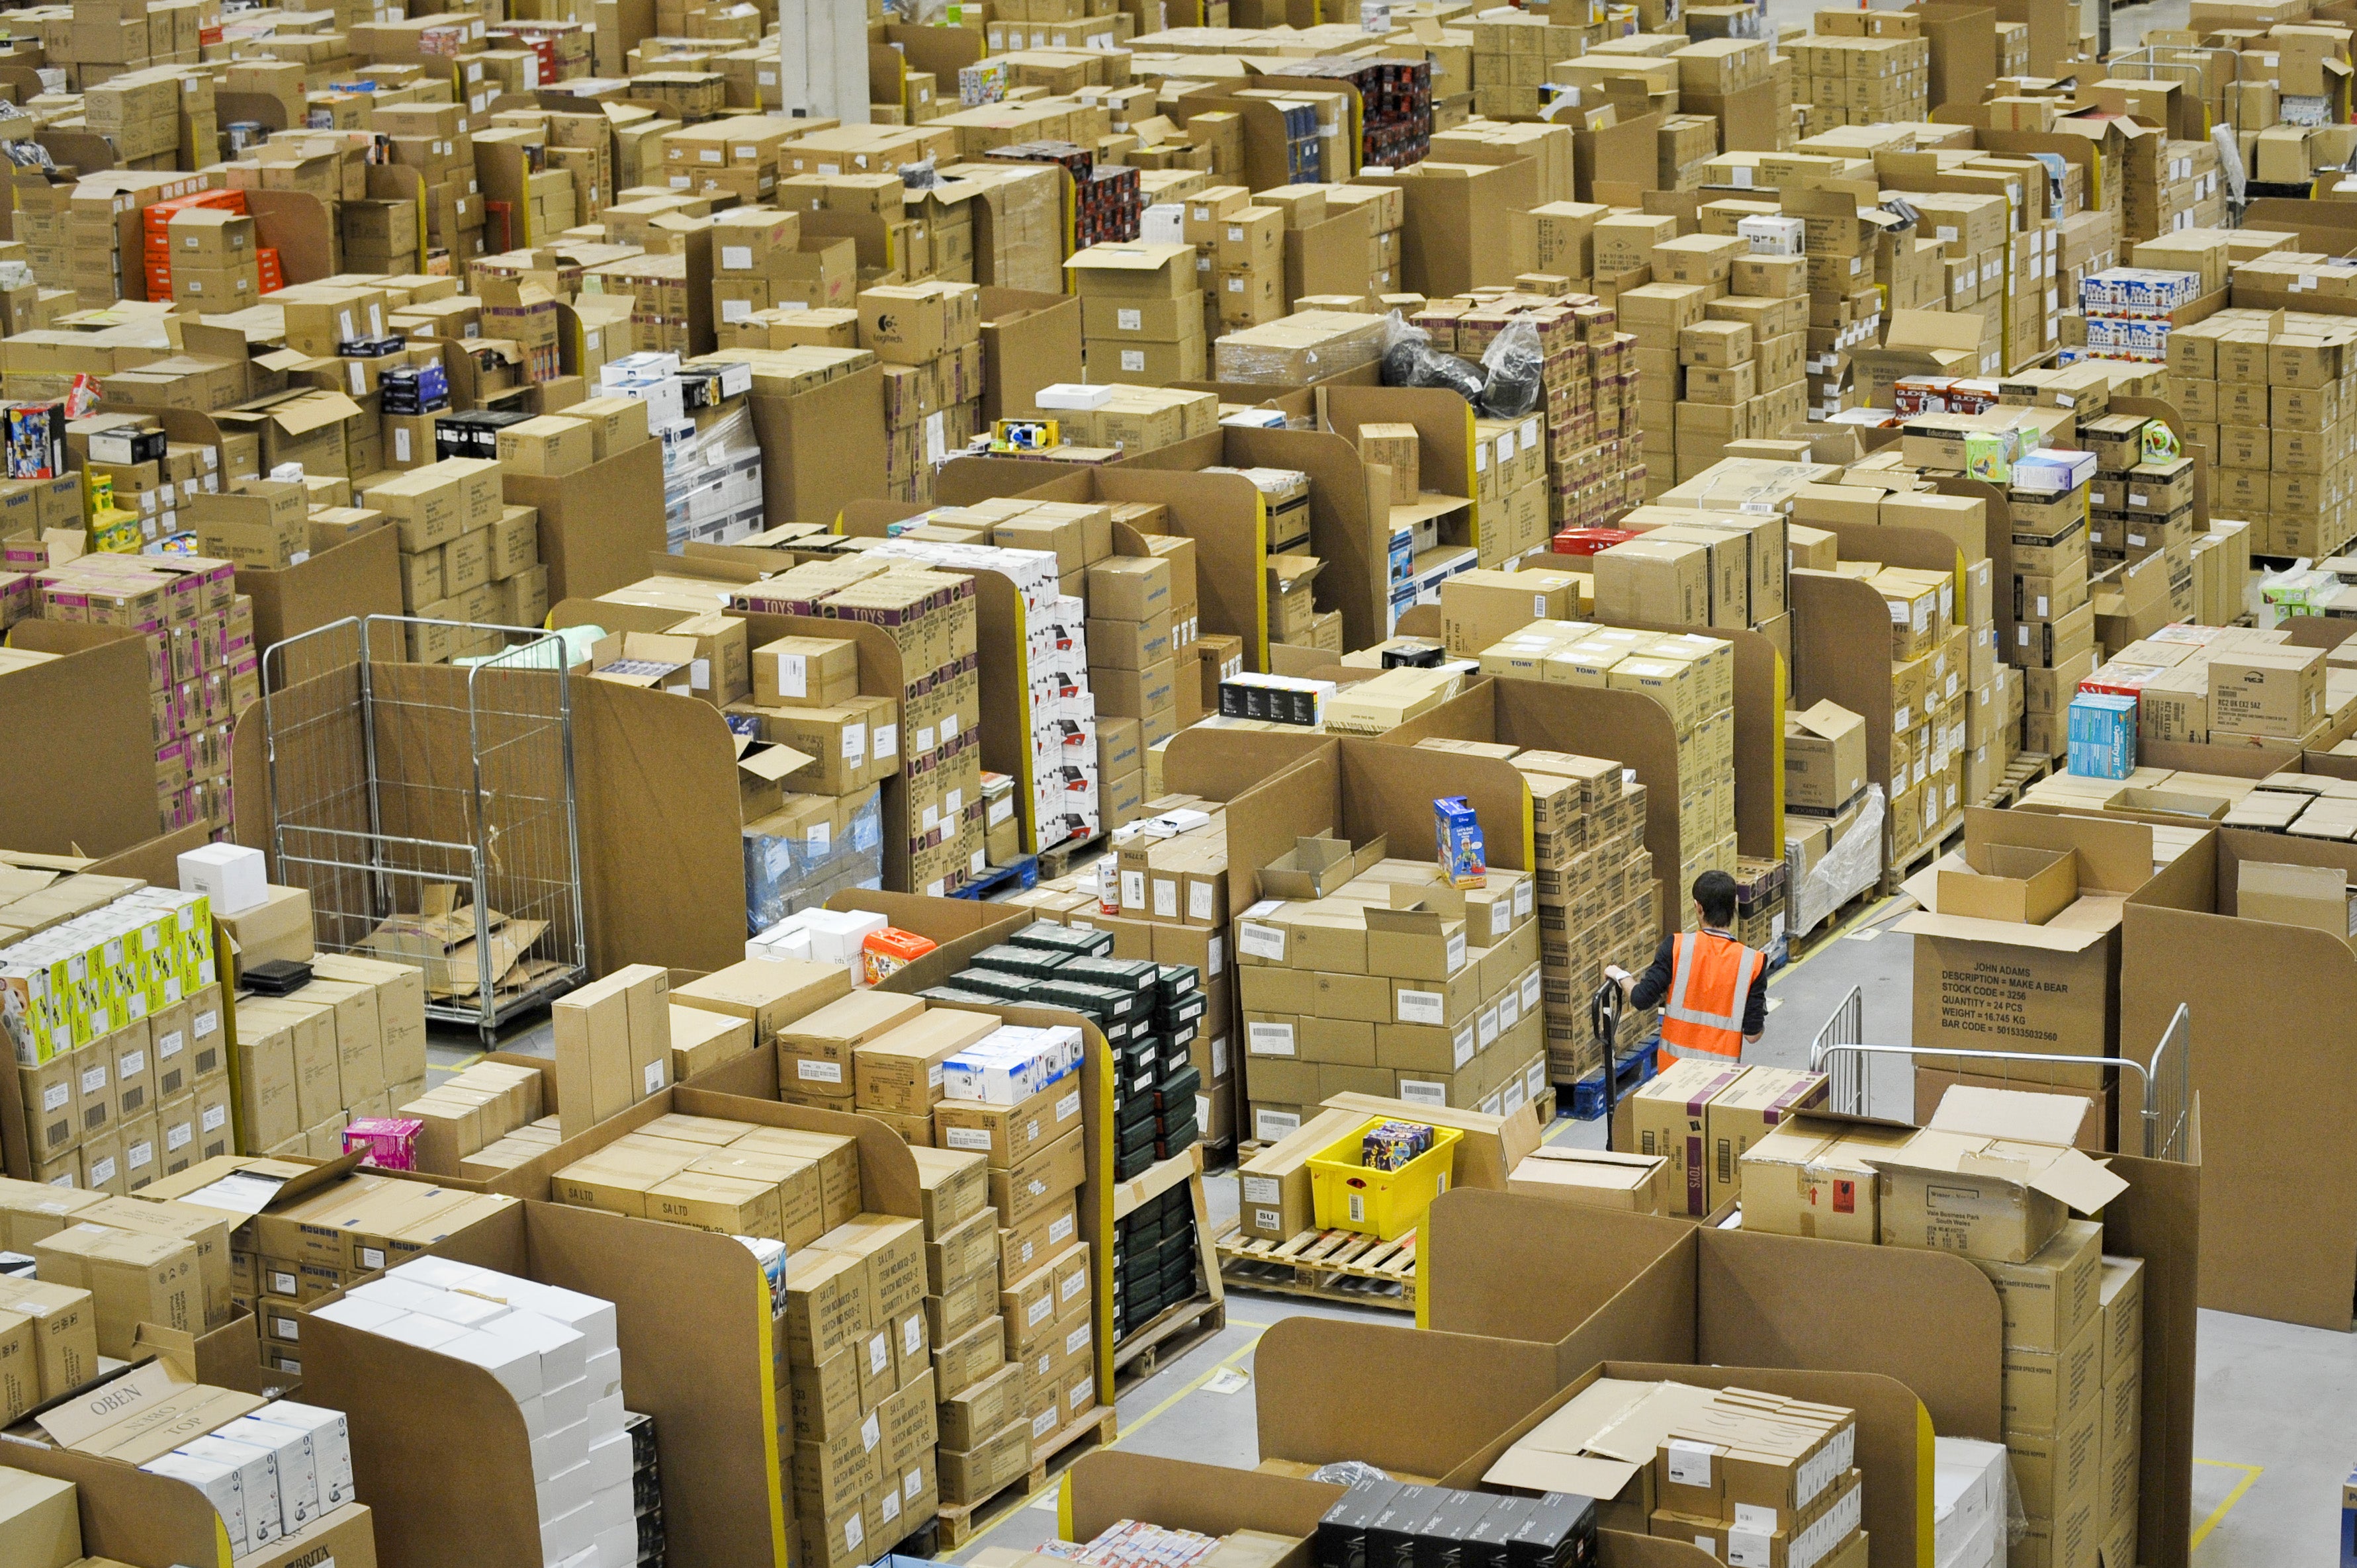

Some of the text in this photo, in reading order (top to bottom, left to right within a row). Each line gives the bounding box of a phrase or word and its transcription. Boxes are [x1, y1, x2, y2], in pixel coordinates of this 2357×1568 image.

[873, 333, 903, 345] Logitech
[1926, 429, 1962, 439] Educational
[53, 481, 76, 494] TOMY
[5, 494, 30, 508] TOMY
[763, 599, 795, 615] TOYS
[851, 607, 885, 625] TOYS
[1575, 667, 1597, 675] TOMY
[1640, 678, 1663, 687] TOMY
[2218, 699, 2229, 707] RC2
[1791, 806, 1829, 816] KENWOOD
[1974, 963, 2031, 977] JOHN ADAMS
[1942, 971, 1999, 985] DESCRIPTION
[2009, 979, 2034, 990] MAKE
[2035, 982, 2042, 991] A
[2044, 982, 2068, 993] BEAR
[1942, 982, 1971, 994] STOCK
[1973, 986, 1998, 998] CODE
[1942, 996, 1984, 1008] QUANTITY
[1994, 1001, 2003, 1010] 24
[2006, 1002, 2023, 1012] PCS
[1942, 1007, 1975, 1019] WEIGHT
[1984, 1012, 2010, 1023] 16.745
[2013, 1016, 2026, 1025] KG
[1941, 1019, 1960, 1029] BAR
[1962, 1022, 1986, 1032] CODE
[1997, 1026, 2058, 1041] 5015335032560
[850, 1036, 864, 1048] omron
[1009, 1109, 1023, 1121] omron
[1011, 1167, 1025, 1178] omron
[1689, 1166, 1701, 1189] TOYS
[569, 1188, 594, 1201] SA LTD
[663, 1203, 688, 1217] SA LTD
[1260, 1213, 1274, 1221] SU
[1006, 1229, 1020, 1242] omron
[878, 1249, 894, 1266] SA LTD
[879, 1269, 890, 1283] ITEM
[820, 1285, 836, 1303] SA LTD
[880, 1283, 895, 1299] BATCH
[911, 1284, 920, 1297] PCS
[821, 1307, 832, 1319] ITEM
[822, 1319, 836, 1335] BATCH
[852, 1319, 862, 1332] PCS
[90, 1384, 144, 1416] OBEN
[890, 1403, 898, 1415] SA
[124, 1405, 177, 1432] OPEN
[891, 1418, 901, 1431] ITEM
[163, 1417, 203, 1436] TOP
[892, 1432, 906, 1447] BATCH
[920, 1430, 930, 1443] PCS
[832, 1437, 848, 1455] SA LTD
[832, 1457, 843, 1470] ITEM
[834, 1471, 848, 1487] BATCH
[864, 1469, 873, 1483] PCS
[1325, 1503, 1347, 1522] PURE
[1373, 1509, 1396, 1528] PURE
[1420, 1516, 1443, 1535] PURE
[1468, 1522, 1491, 1540] PURE
[1514, 1520, 1536, 1540] PURE
[293, 1544, 332, 1568] BRITA
